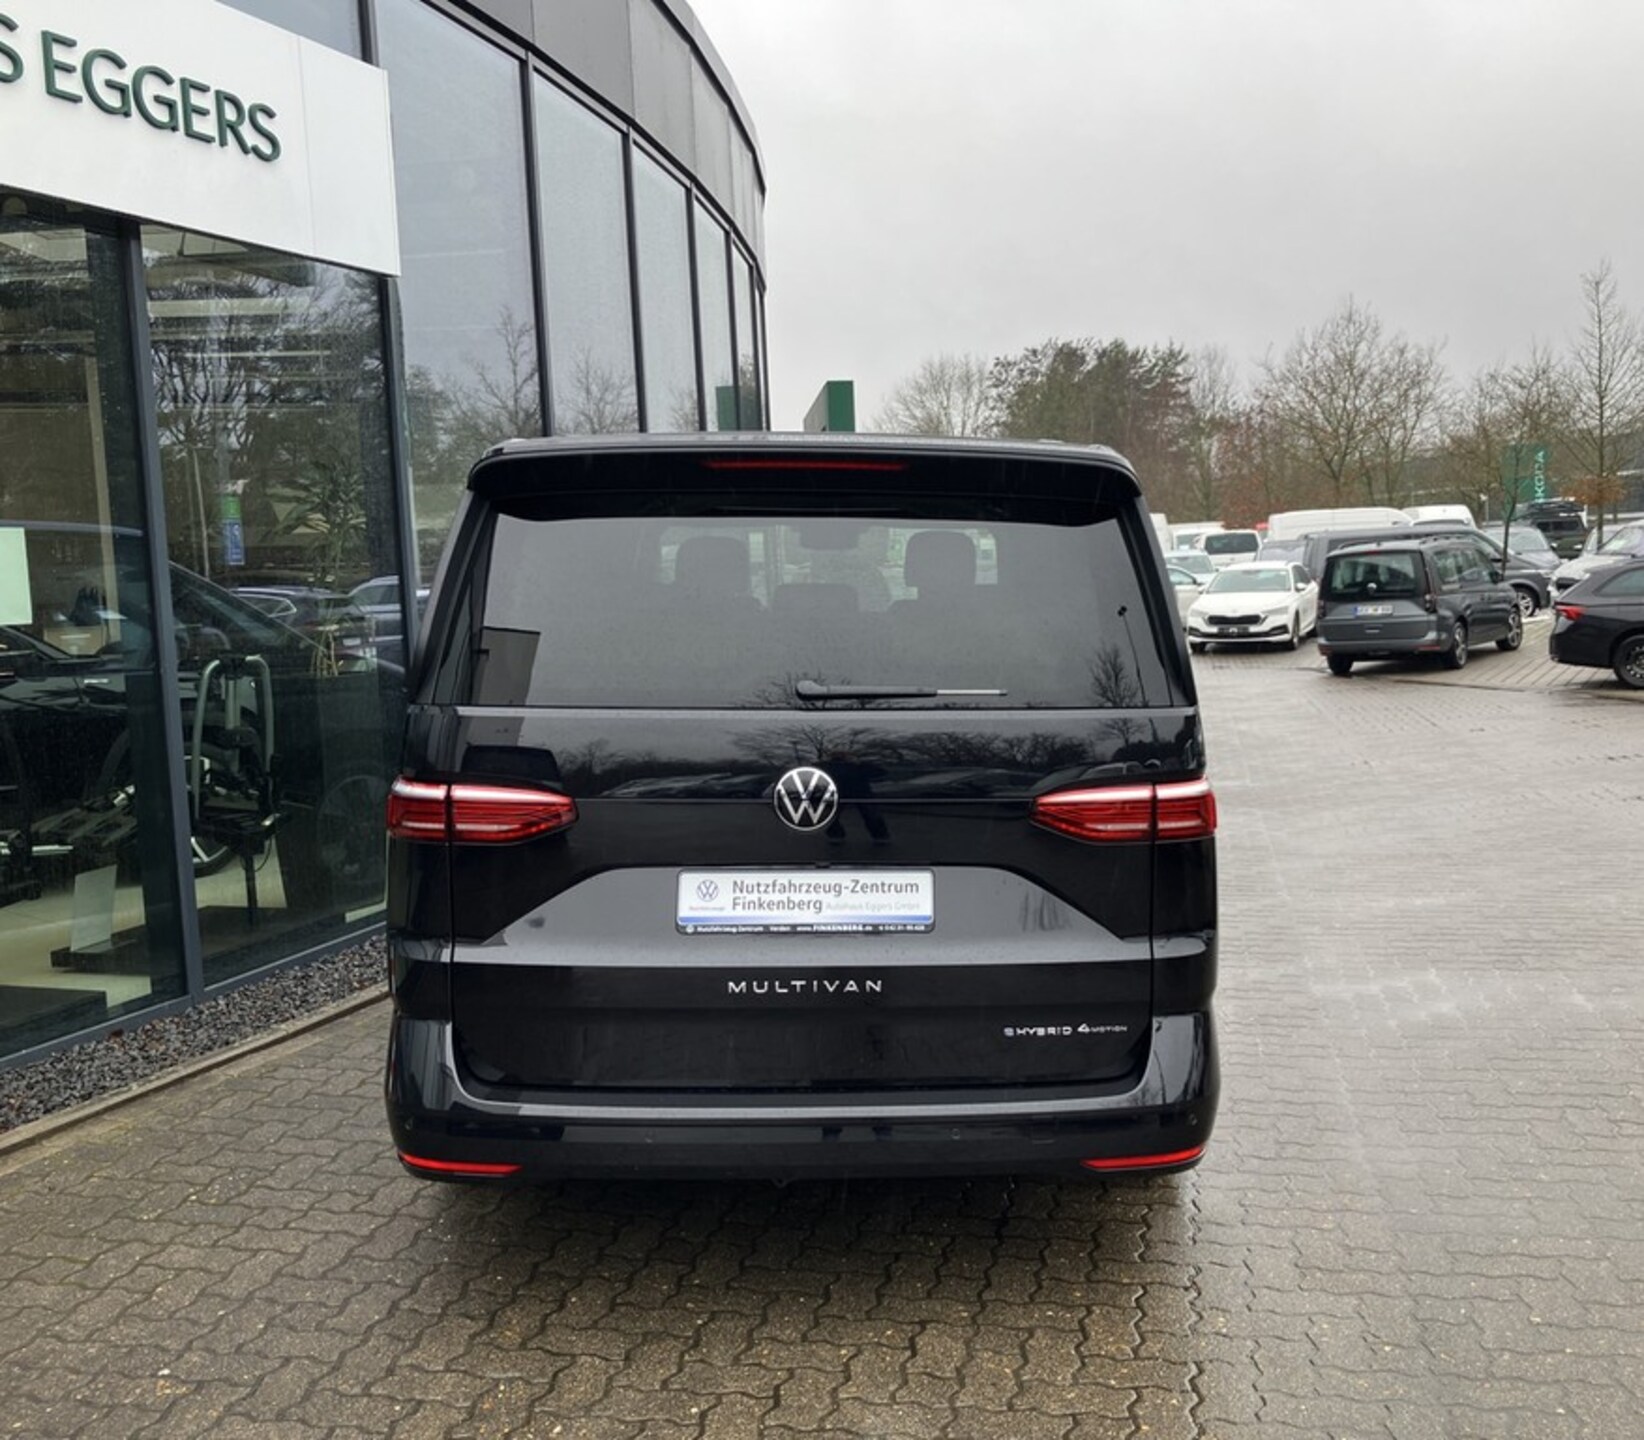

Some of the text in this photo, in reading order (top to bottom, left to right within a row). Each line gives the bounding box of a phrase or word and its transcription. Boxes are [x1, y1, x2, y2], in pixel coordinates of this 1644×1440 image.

[41, 29, 281, 163] EGGERS
[732, 879, 920, 897] Nutzfahrzeug-Zentrum
[732, 897, 823, 914] Finkenberg
[727, 979, 883, 993] MULTIVAN
